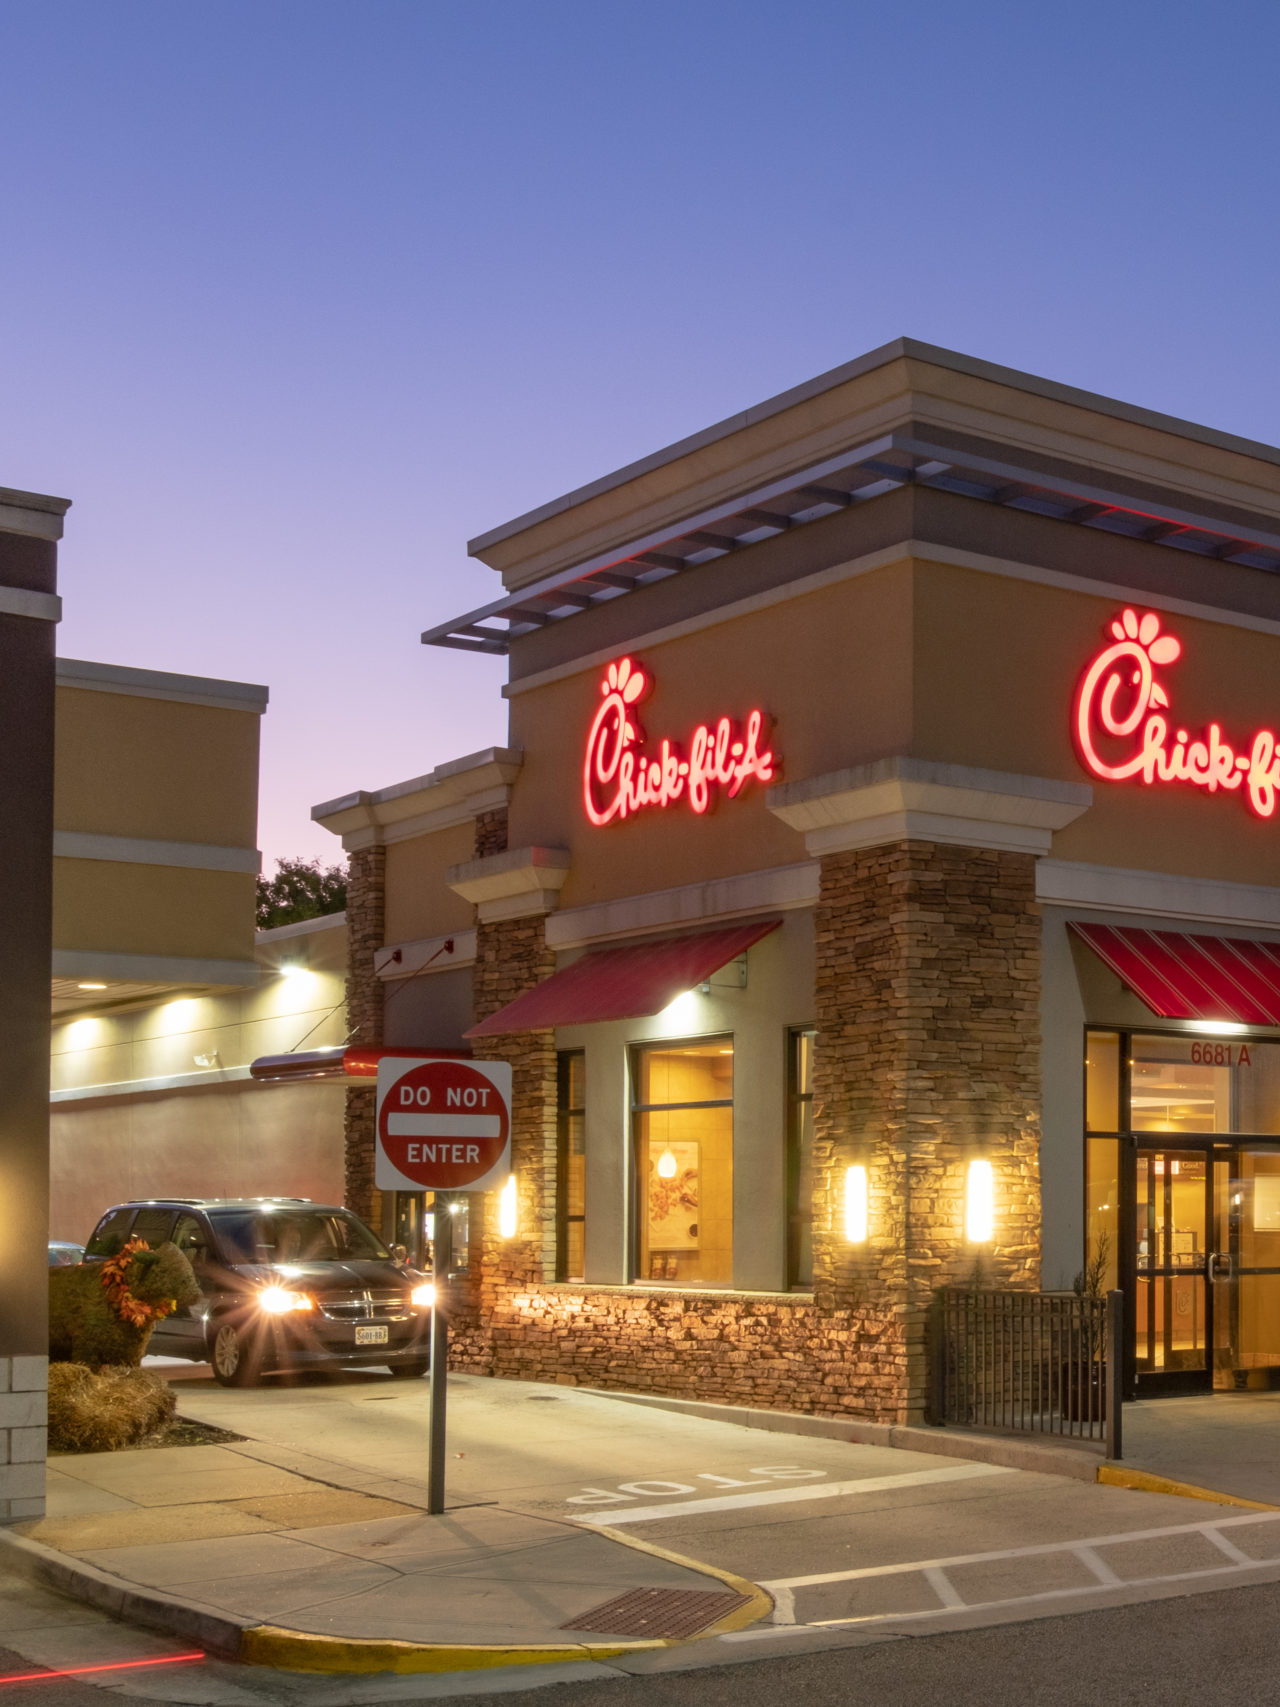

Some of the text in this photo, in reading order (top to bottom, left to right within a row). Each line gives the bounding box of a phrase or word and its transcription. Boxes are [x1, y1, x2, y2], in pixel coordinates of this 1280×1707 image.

[584, 692, 774, 826] Chick-fil-A
[1190, 1041, 1251, 1068] 6681 A
[399, 1086, 491, 1108] DO NOT
[407, 1143, 480, 1164] ENTER
[566, 1465, 828, 1505] STOP
